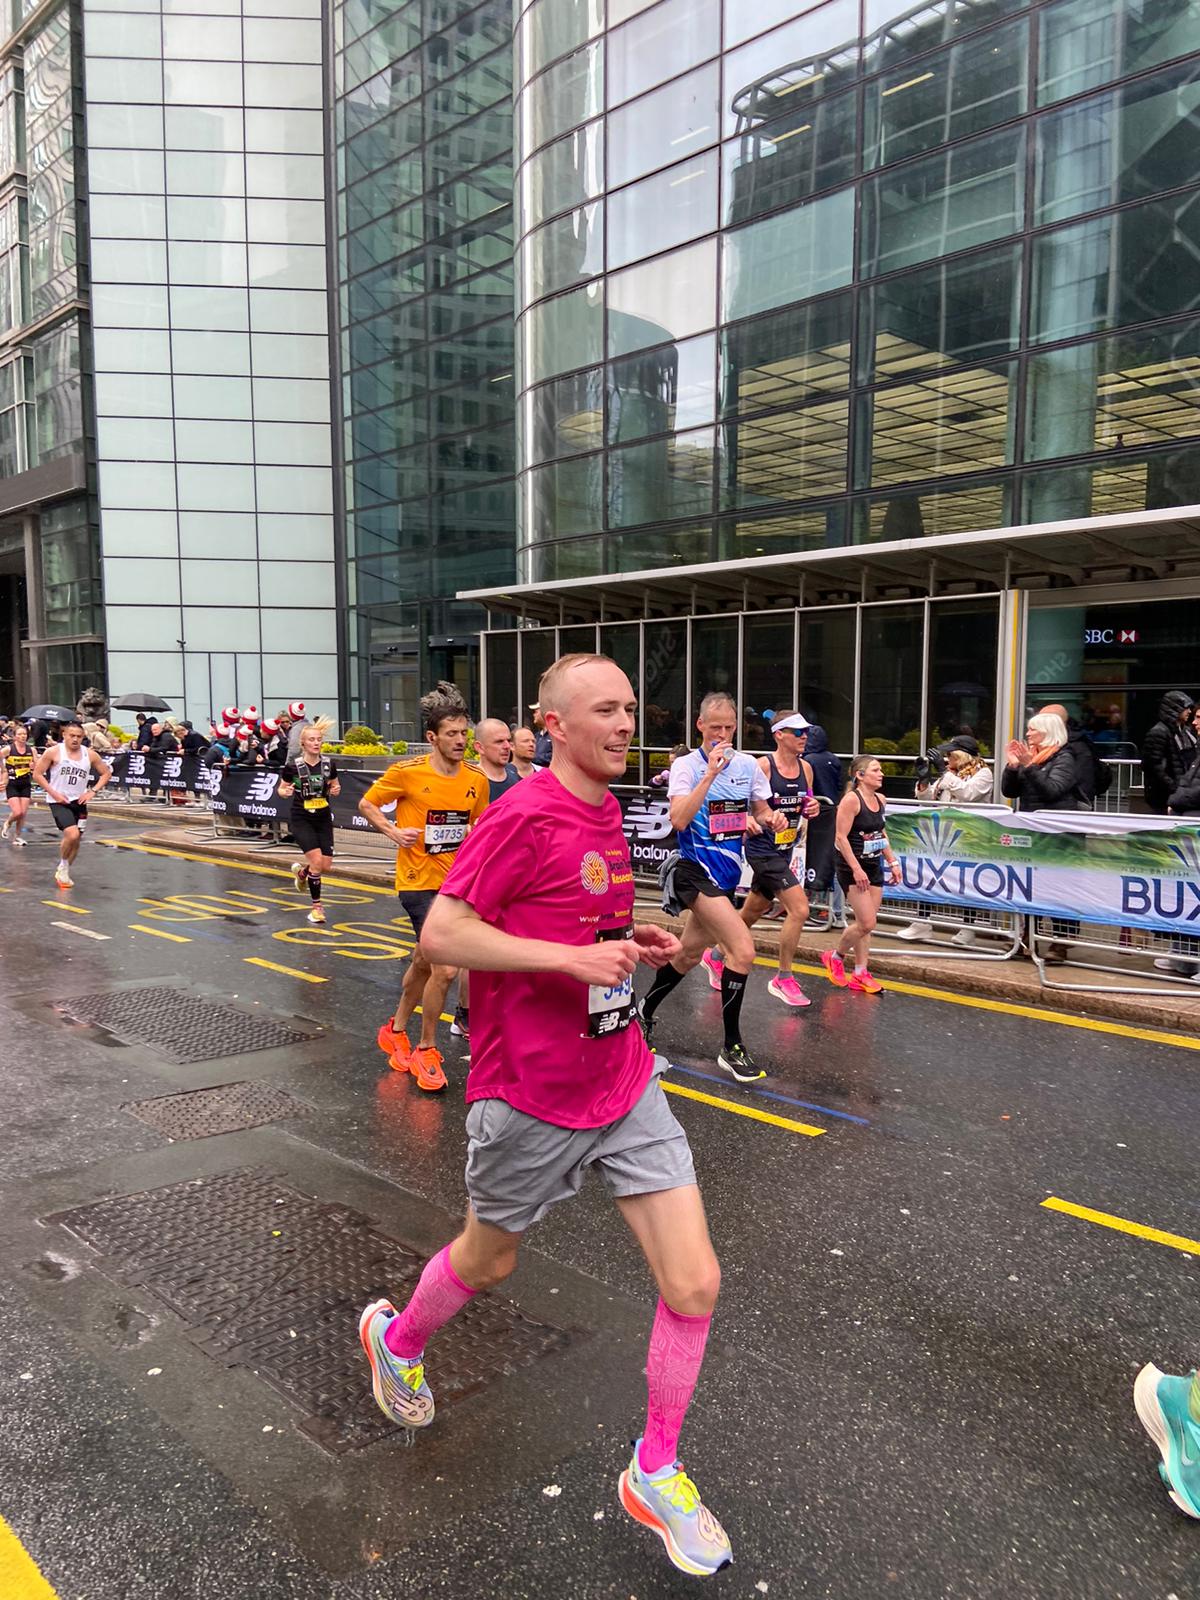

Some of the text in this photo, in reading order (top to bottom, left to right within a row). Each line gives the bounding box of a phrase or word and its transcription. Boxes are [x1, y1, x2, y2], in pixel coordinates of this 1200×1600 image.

[1084, 629, 1114, 644] SBC
[60, 766, 88, 780] BRAVES
[67, 775, 78, 786] 10
[238, 803, 277, 817] new balance
[432, 829, 463, 841] 34735
[633, 843, 671, 860] balan
